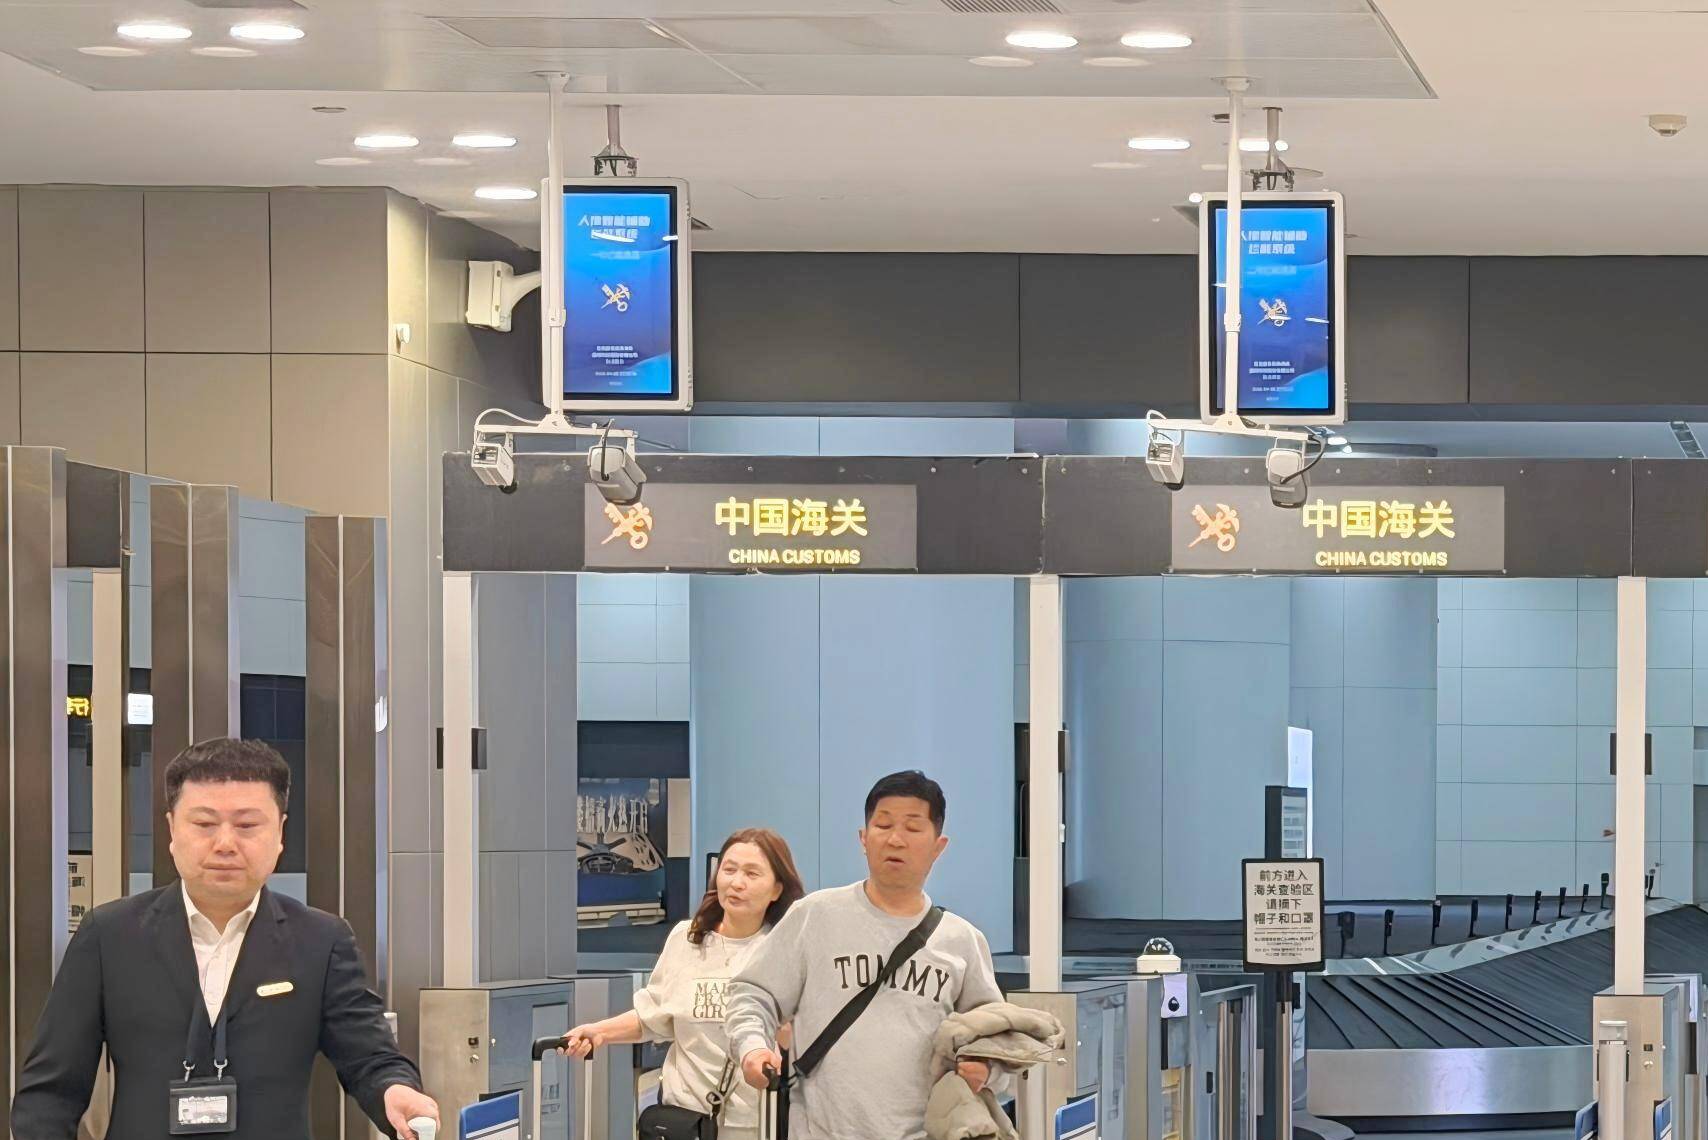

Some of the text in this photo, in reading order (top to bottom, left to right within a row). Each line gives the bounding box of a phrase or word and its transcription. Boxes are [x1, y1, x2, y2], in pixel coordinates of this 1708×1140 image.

[715, 497, 868, 537] 中国海关
[1302, 499, 1455, 539] 中国海关
[728, 549, 861, 564] CHINA CUSTOMS
[1315, 551, 1448, 566] CHINA CUSTOMS
